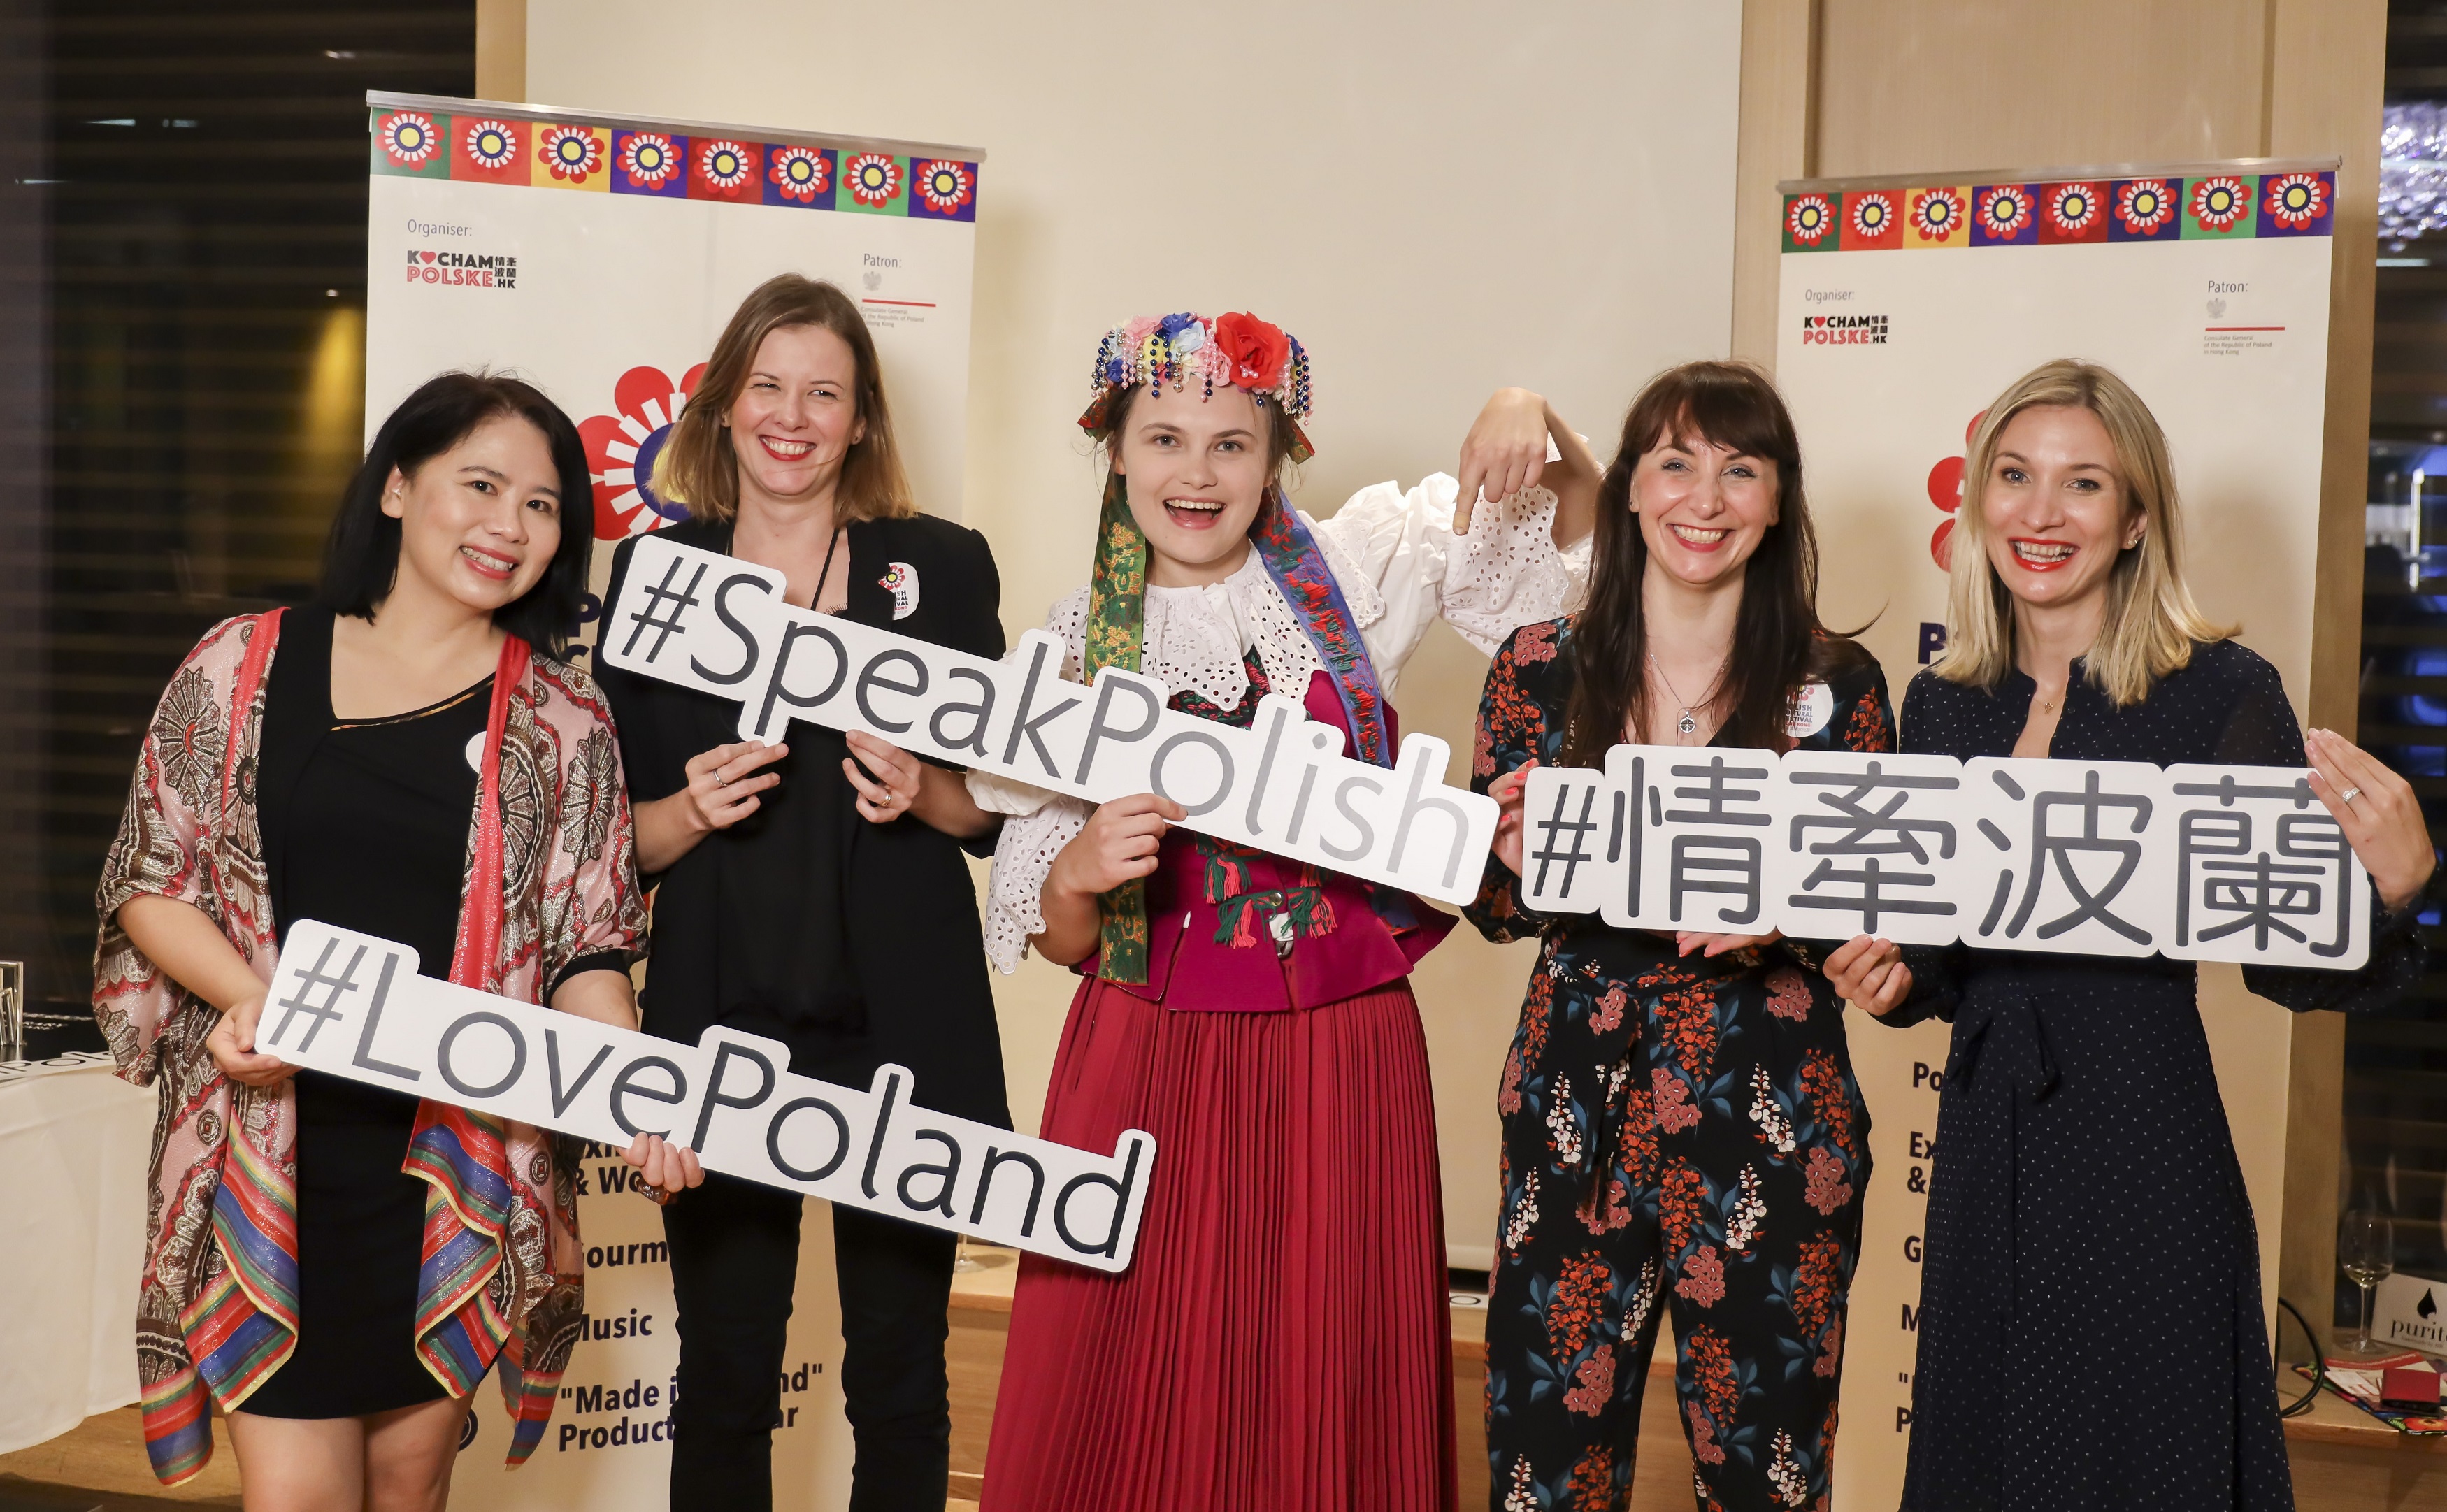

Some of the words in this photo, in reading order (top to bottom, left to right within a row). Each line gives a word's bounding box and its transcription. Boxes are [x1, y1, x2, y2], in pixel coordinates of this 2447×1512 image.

[408, 219, 473, 238] Organiser:
[863, 253, 902, 268] Patron:
[407, 266, 493, 287] POLSKE
[2208, 280, 2248, 294] Patron:
[1805, 289, 1856, 305] Organiser:
[1803, 329, 1870, 345] POLSKE
[620, 556, 1469, 889] #SpeakPolish
[1531, 755, 2352, 958] #情牽波蘭
[268, 937, 1143, 1260] #LovePoland
[583, 1241, 668, 1269] ourm
[561, 1378, 660, 1414] "Made
[559, 1416, 675, 1452] Product
